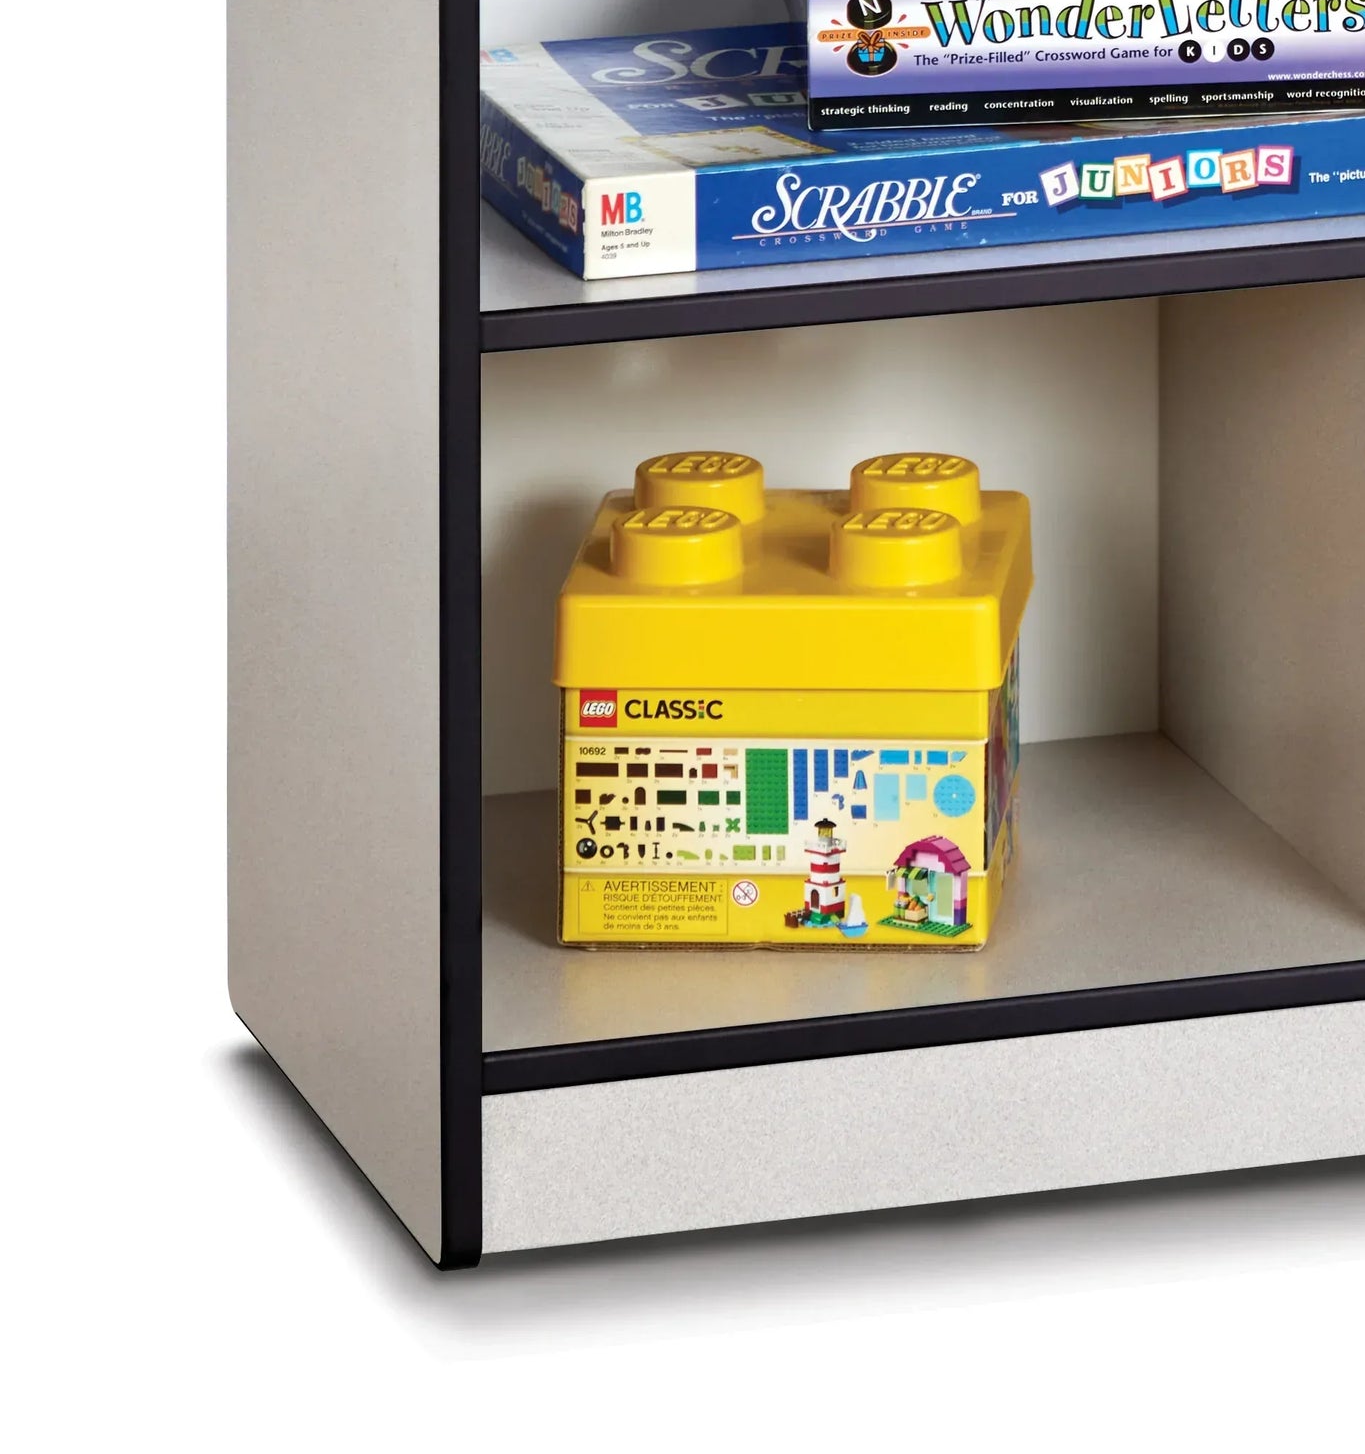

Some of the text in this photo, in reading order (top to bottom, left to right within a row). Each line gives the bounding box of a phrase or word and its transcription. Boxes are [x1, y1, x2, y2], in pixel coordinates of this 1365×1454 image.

[822, 29, 925, 40] PRIZE INSIDE
[914, 54, 939, 66] The
[1035, 46, 1106, 62] Crossword
[1110, 46, 1149, 59] Game
[1153, 46, 1173, 58] for
[1182, 41, 1270, 60] KIDS
[821, 105, 865, 117] strategic
[868, 103, 910, 115] thinking
[929, 102, 968, 113] reading
[984, 98, 1054, 109] concentration
[1070, 95, 1133, 107] visualization
[1149, 93, 1189, 105] spelling
[1201, 90, 1274, 102] sportsmanship
[1287, 88, 1312, 99] word
[752, 172, 978, 238] SCRABBLE
[1001, 191, 1038, 206] FOR
[1045, 150, 1289, 201] JUNIORS
[1308, 172, 1330, 183] The
[601, 191, 643, 225] MB
[601, 227, 653, 238] Milton Bradley
[760, 222, 968, 247] CROSSWORD GAME
[601, 243, 618, 252] Ages
[640, 240, 651, 249] Up
[650, 456, 751, 474] LEGO
[864, 457, 967, 475] LEGO
[624, 510, 729, 529] LEGO
[843, 512, 947, 530] LEGO
[582, 700, 616, 717] LEGO
[579, 747, 606, 755] 10692
[604, 881, 717, 892] AVERTISSEMENT
[604, 894, 639, 903] RISQUE
[604, 903, 638, 911] Contient
[640, 903, 656, 911] des
[658, 903, 685, 913] petites
[617, 913, 652, 921] convient
[654, 914, 670, 922] pas
